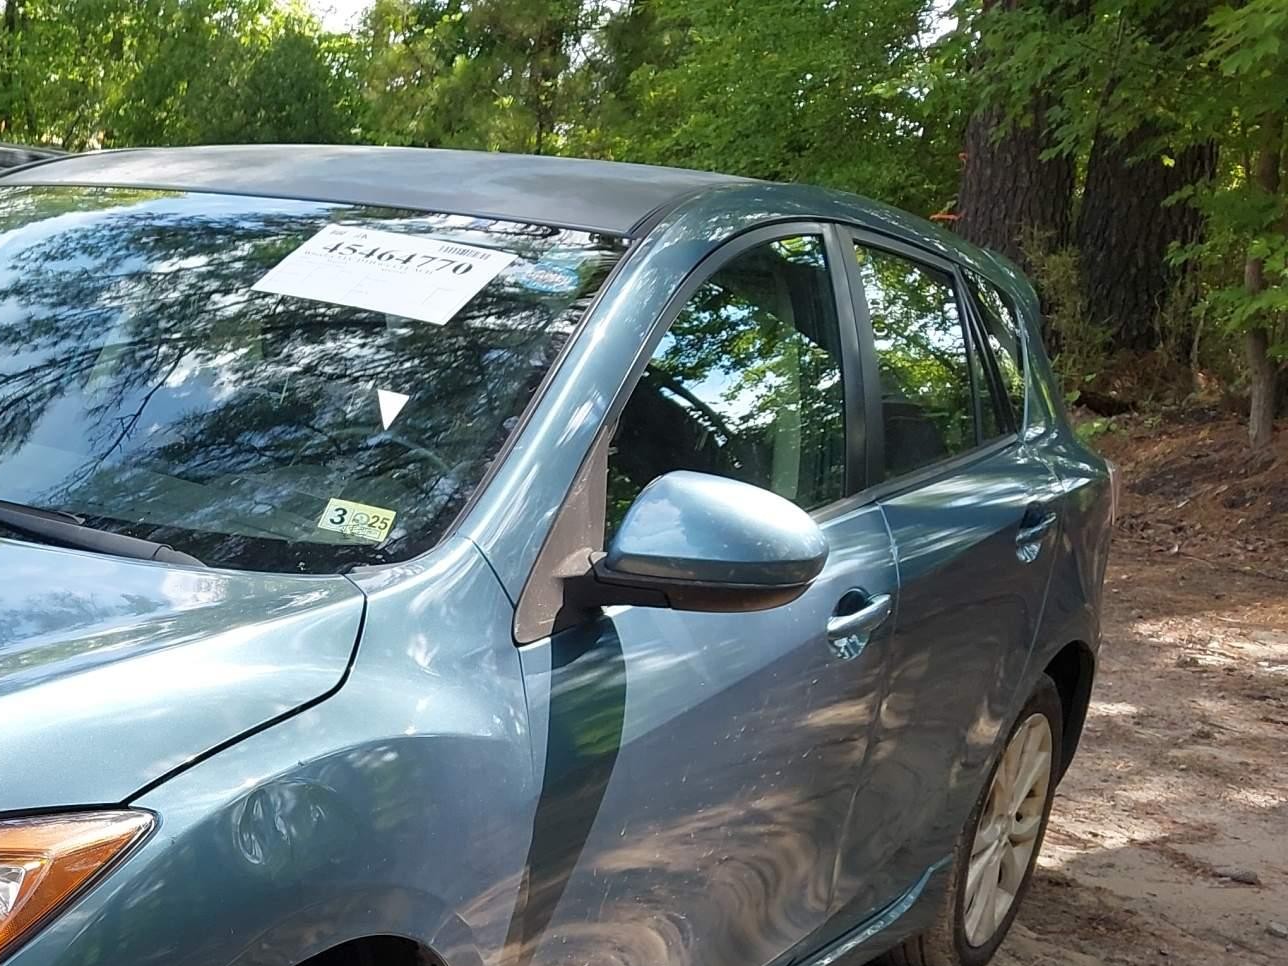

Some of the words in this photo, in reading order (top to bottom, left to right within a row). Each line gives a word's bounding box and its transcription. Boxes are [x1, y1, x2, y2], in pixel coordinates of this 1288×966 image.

[323, 241, 473, 275] 45464770
[329, 507, 347, 525] 3
[368, 514, 391, 530] 25
